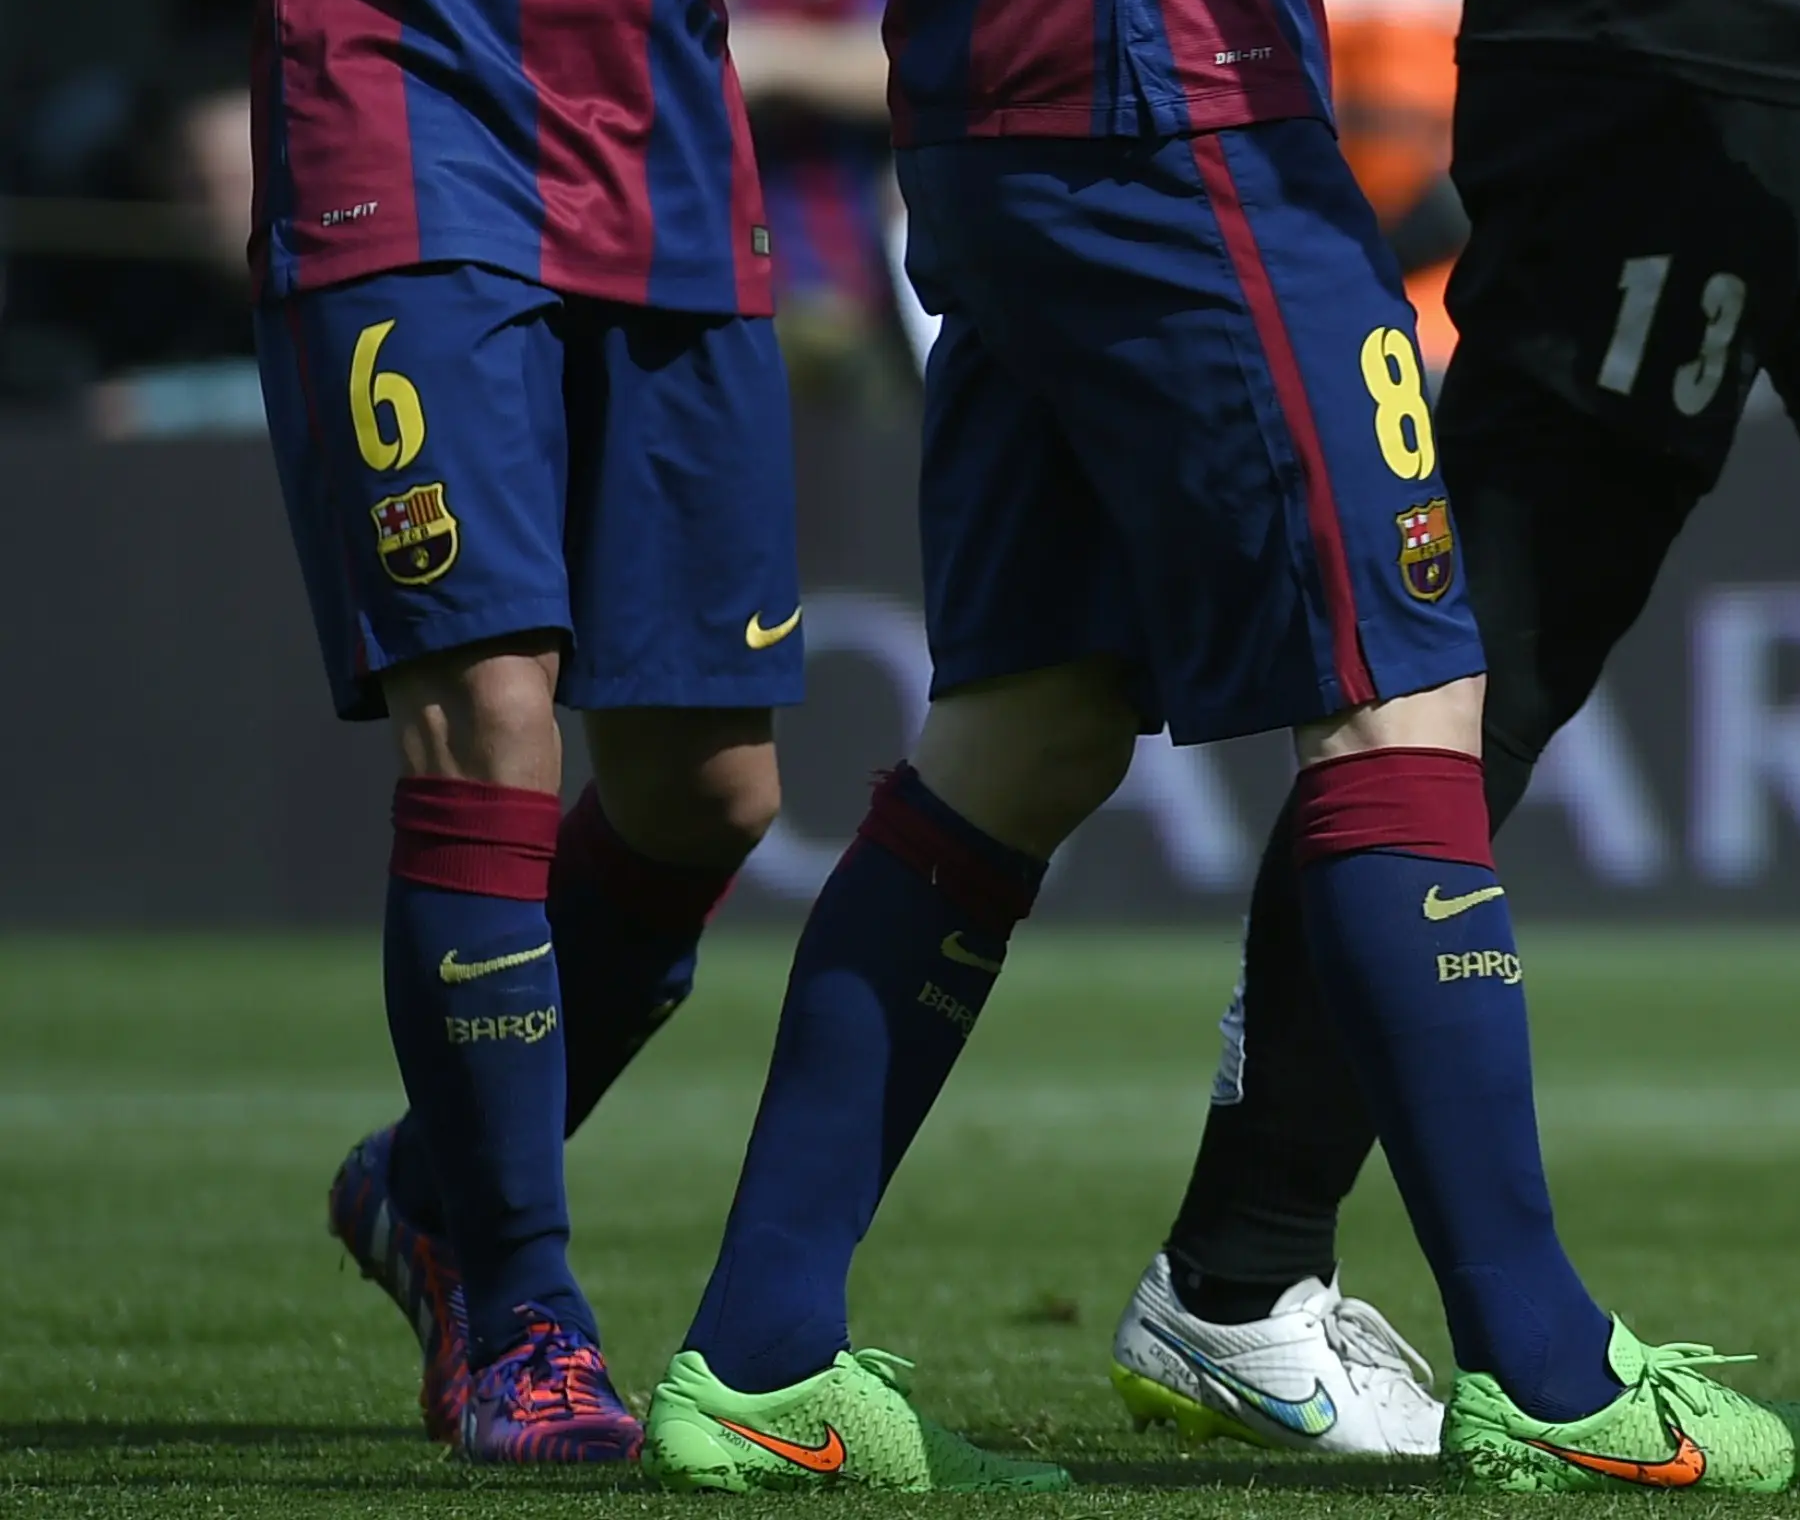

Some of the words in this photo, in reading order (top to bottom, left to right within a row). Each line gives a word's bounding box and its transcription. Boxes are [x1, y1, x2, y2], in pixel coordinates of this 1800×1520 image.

[1215, 47, 1272, 65] DRI-FIT
[1597, 254, 1746, 416] 13
[350, 319, 426, 471] 6
[1361, 326, 1435, 480] 8
[1437, 950, 1522, 985] BARÇ
[445, 1004, 557, 1044] BARÇA
